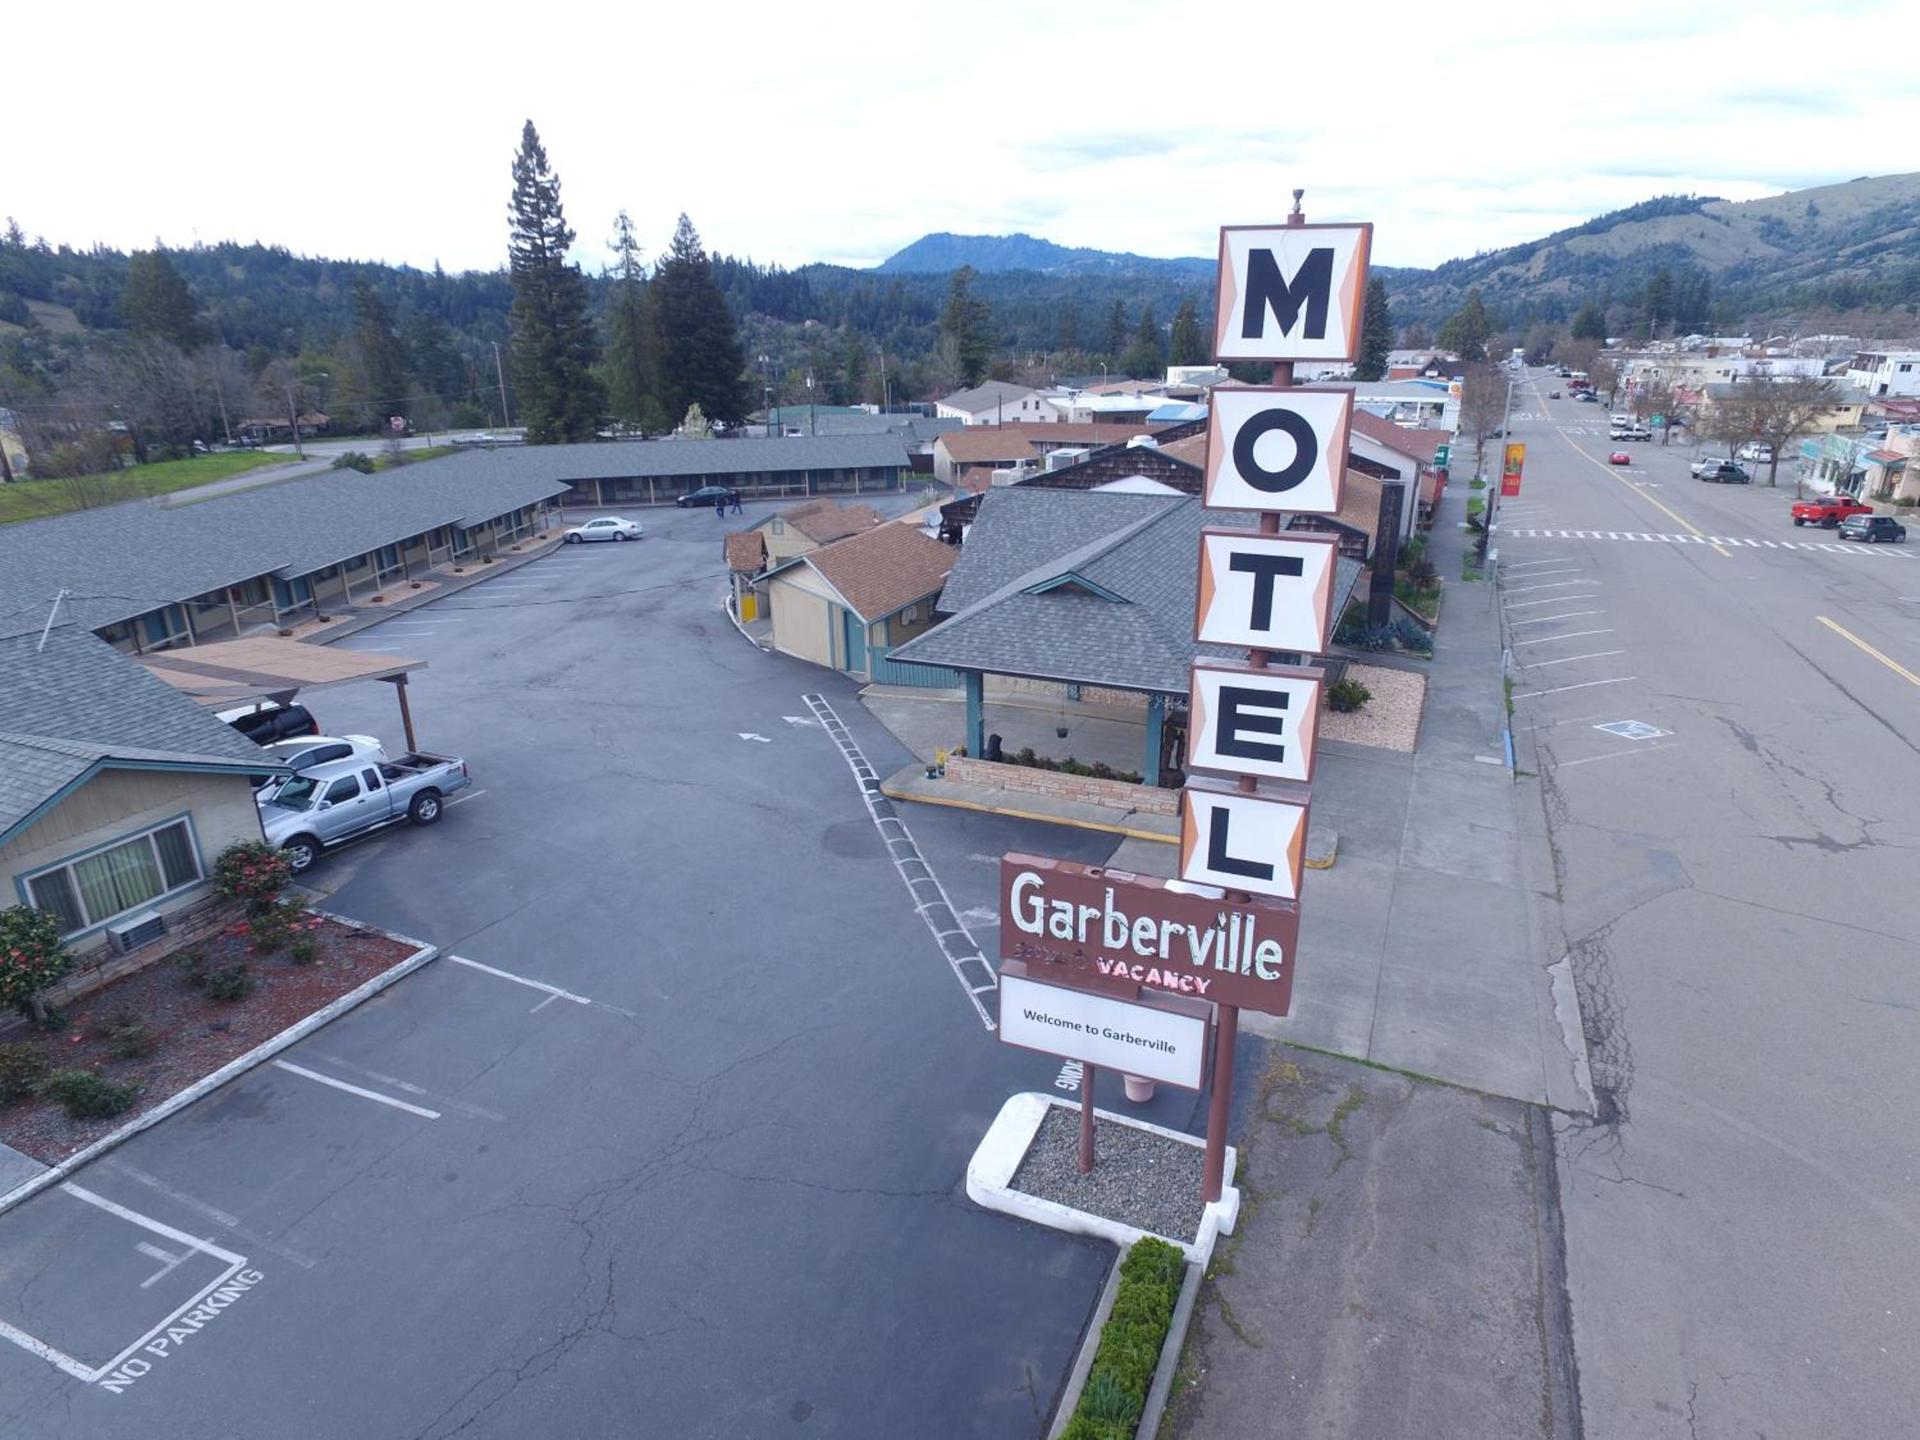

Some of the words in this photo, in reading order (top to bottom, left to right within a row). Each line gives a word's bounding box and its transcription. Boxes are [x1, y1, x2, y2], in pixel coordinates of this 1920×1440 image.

[1206, 248, 1335, 881] MOTEL
[1010, 872, 1283, 981] Garberville
[1097, 957, 1212, 995] VACANCY
[1023, 1008, 1082, 1033] Welcome
[1086, 1023, 1100, 1036] to
[1102, 1028, 1177, 1055] Garberville
[1054, 1059, 1084, 1091] KING
[100, 1358, 152, 1394] NO
[145, 1268, 265, 1358] PARKING
